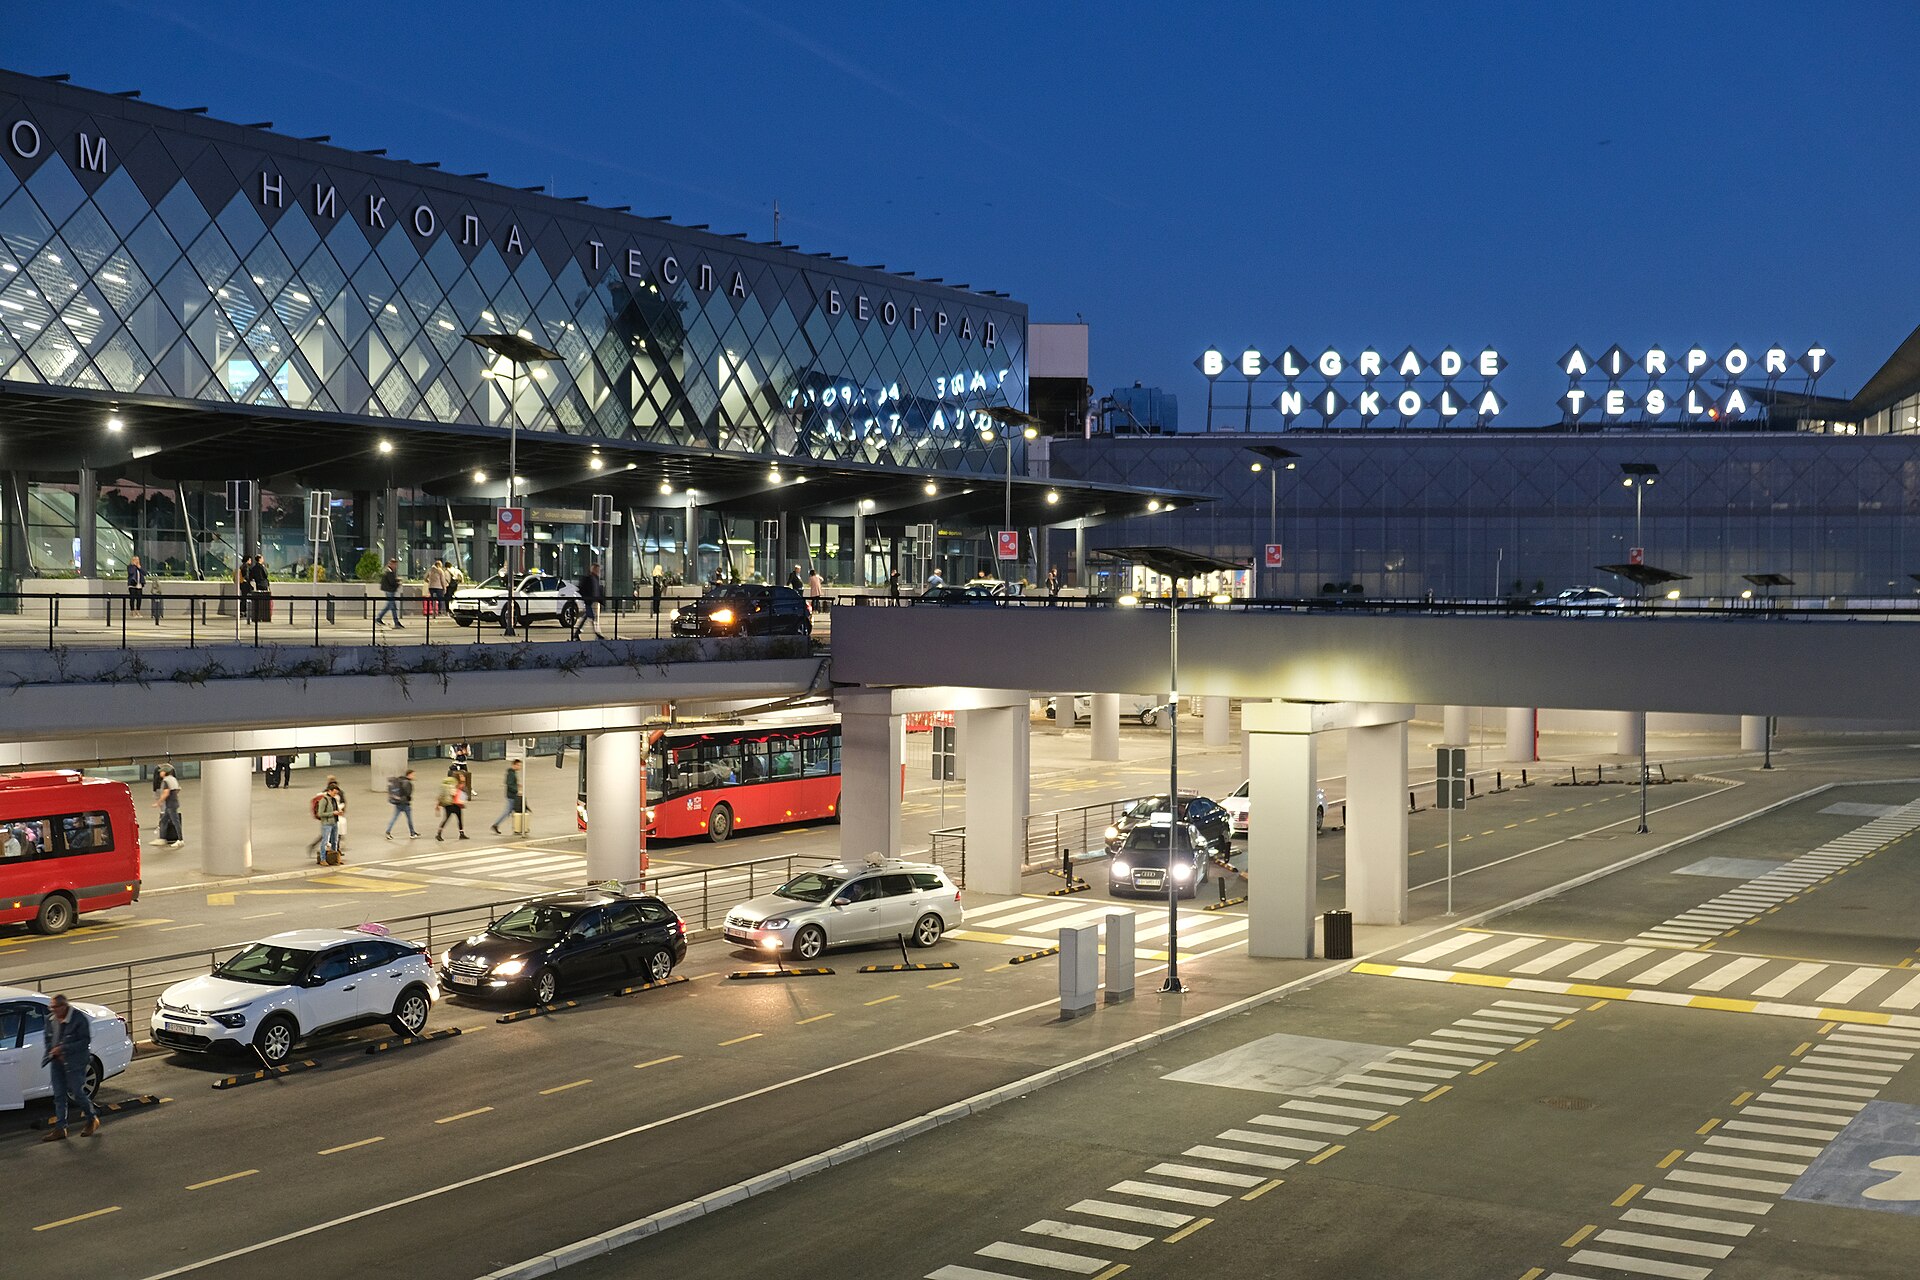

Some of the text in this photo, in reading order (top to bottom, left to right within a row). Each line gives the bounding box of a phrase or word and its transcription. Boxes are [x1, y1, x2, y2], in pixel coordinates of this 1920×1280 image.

[262, 171, 525, 256] НИКОЛА
[589, 240, 747, 299] ТЕСЛА
[828, 289, 997, 350] БЕОГРАД
[1203, 348, 1826, 376] BELGRADE AIRPORT
[1281, 389, 1746, 416] NIKOLA TESLA
